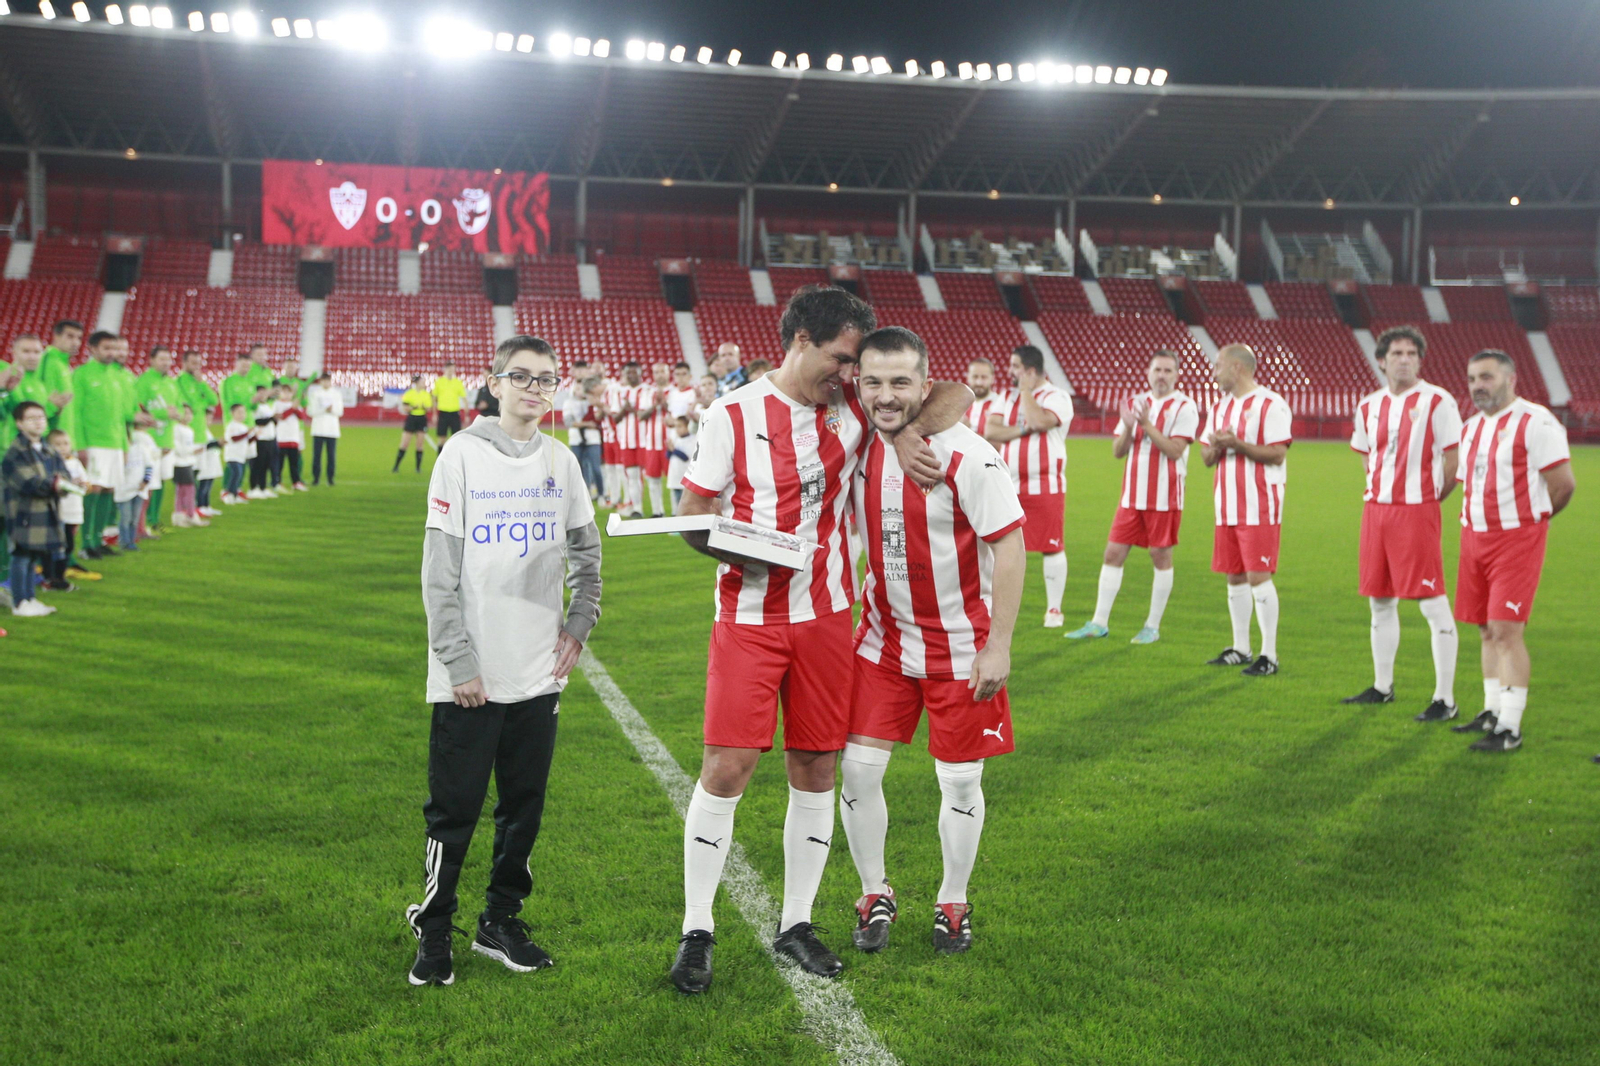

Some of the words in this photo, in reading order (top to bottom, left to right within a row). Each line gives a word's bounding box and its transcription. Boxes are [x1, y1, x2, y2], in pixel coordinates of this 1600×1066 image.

[375, 197, 398, 223] 0
[420, 199, 442, 225] 0
[470, 490, 496, 500] Todos
[499, 491, 516, 499] con
[518, 487, 540, 498] JOSÉ
[542, 488, 563, 498] ORTIZ
[533, 509, 556, 518] cáncer
[472, 522, 556, 558] argar
